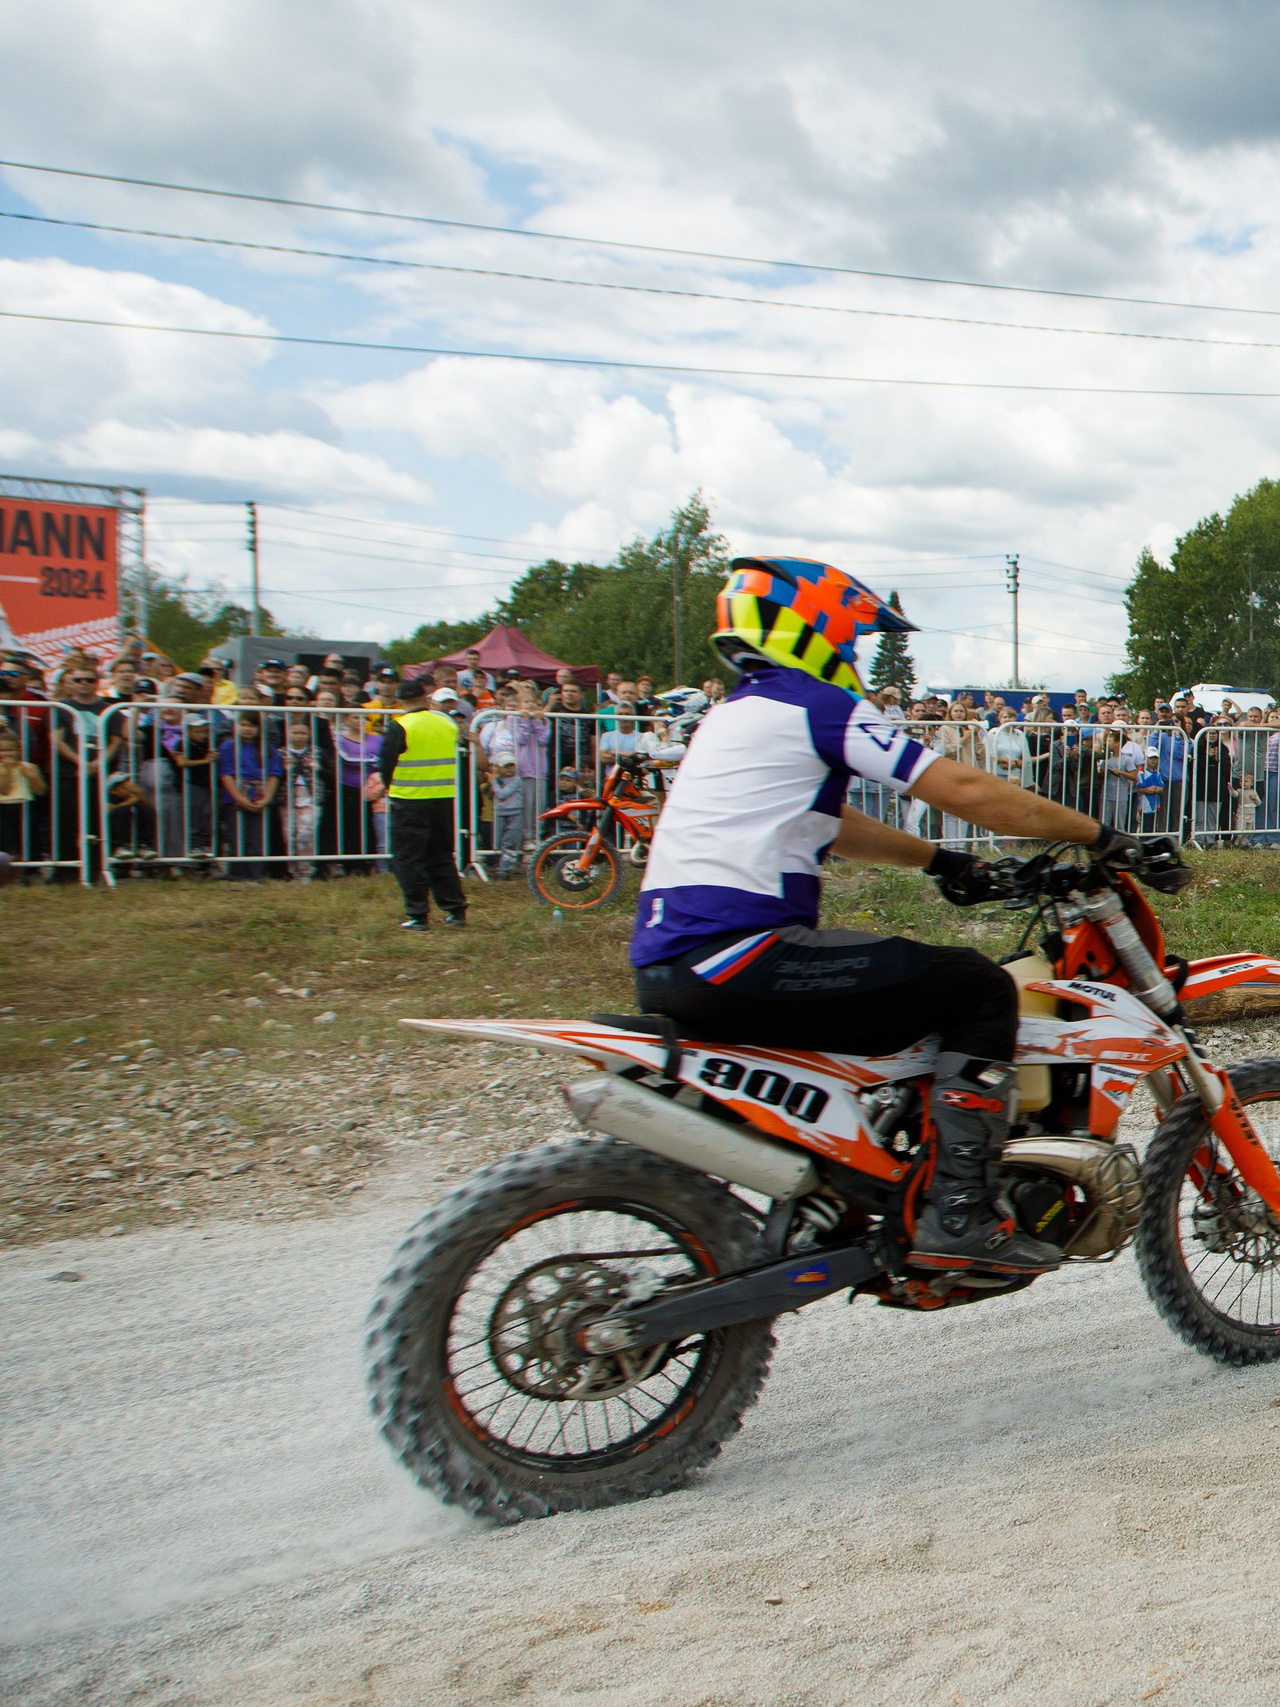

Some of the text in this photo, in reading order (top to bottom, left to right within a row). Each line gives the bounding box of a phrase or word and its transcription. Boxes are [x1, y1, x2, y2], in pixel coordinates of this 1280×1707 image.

[0, 508, 104, 561] ANN
[40, 566, 105, 599] 2024
[775, 957, 871, 976] ЭНДУРО
[772, 976, 859, 991] ПЕРМЬ
[1068, 981, 1118, 1002] MOTUL
[699, 1058, 830, 1124] 900
